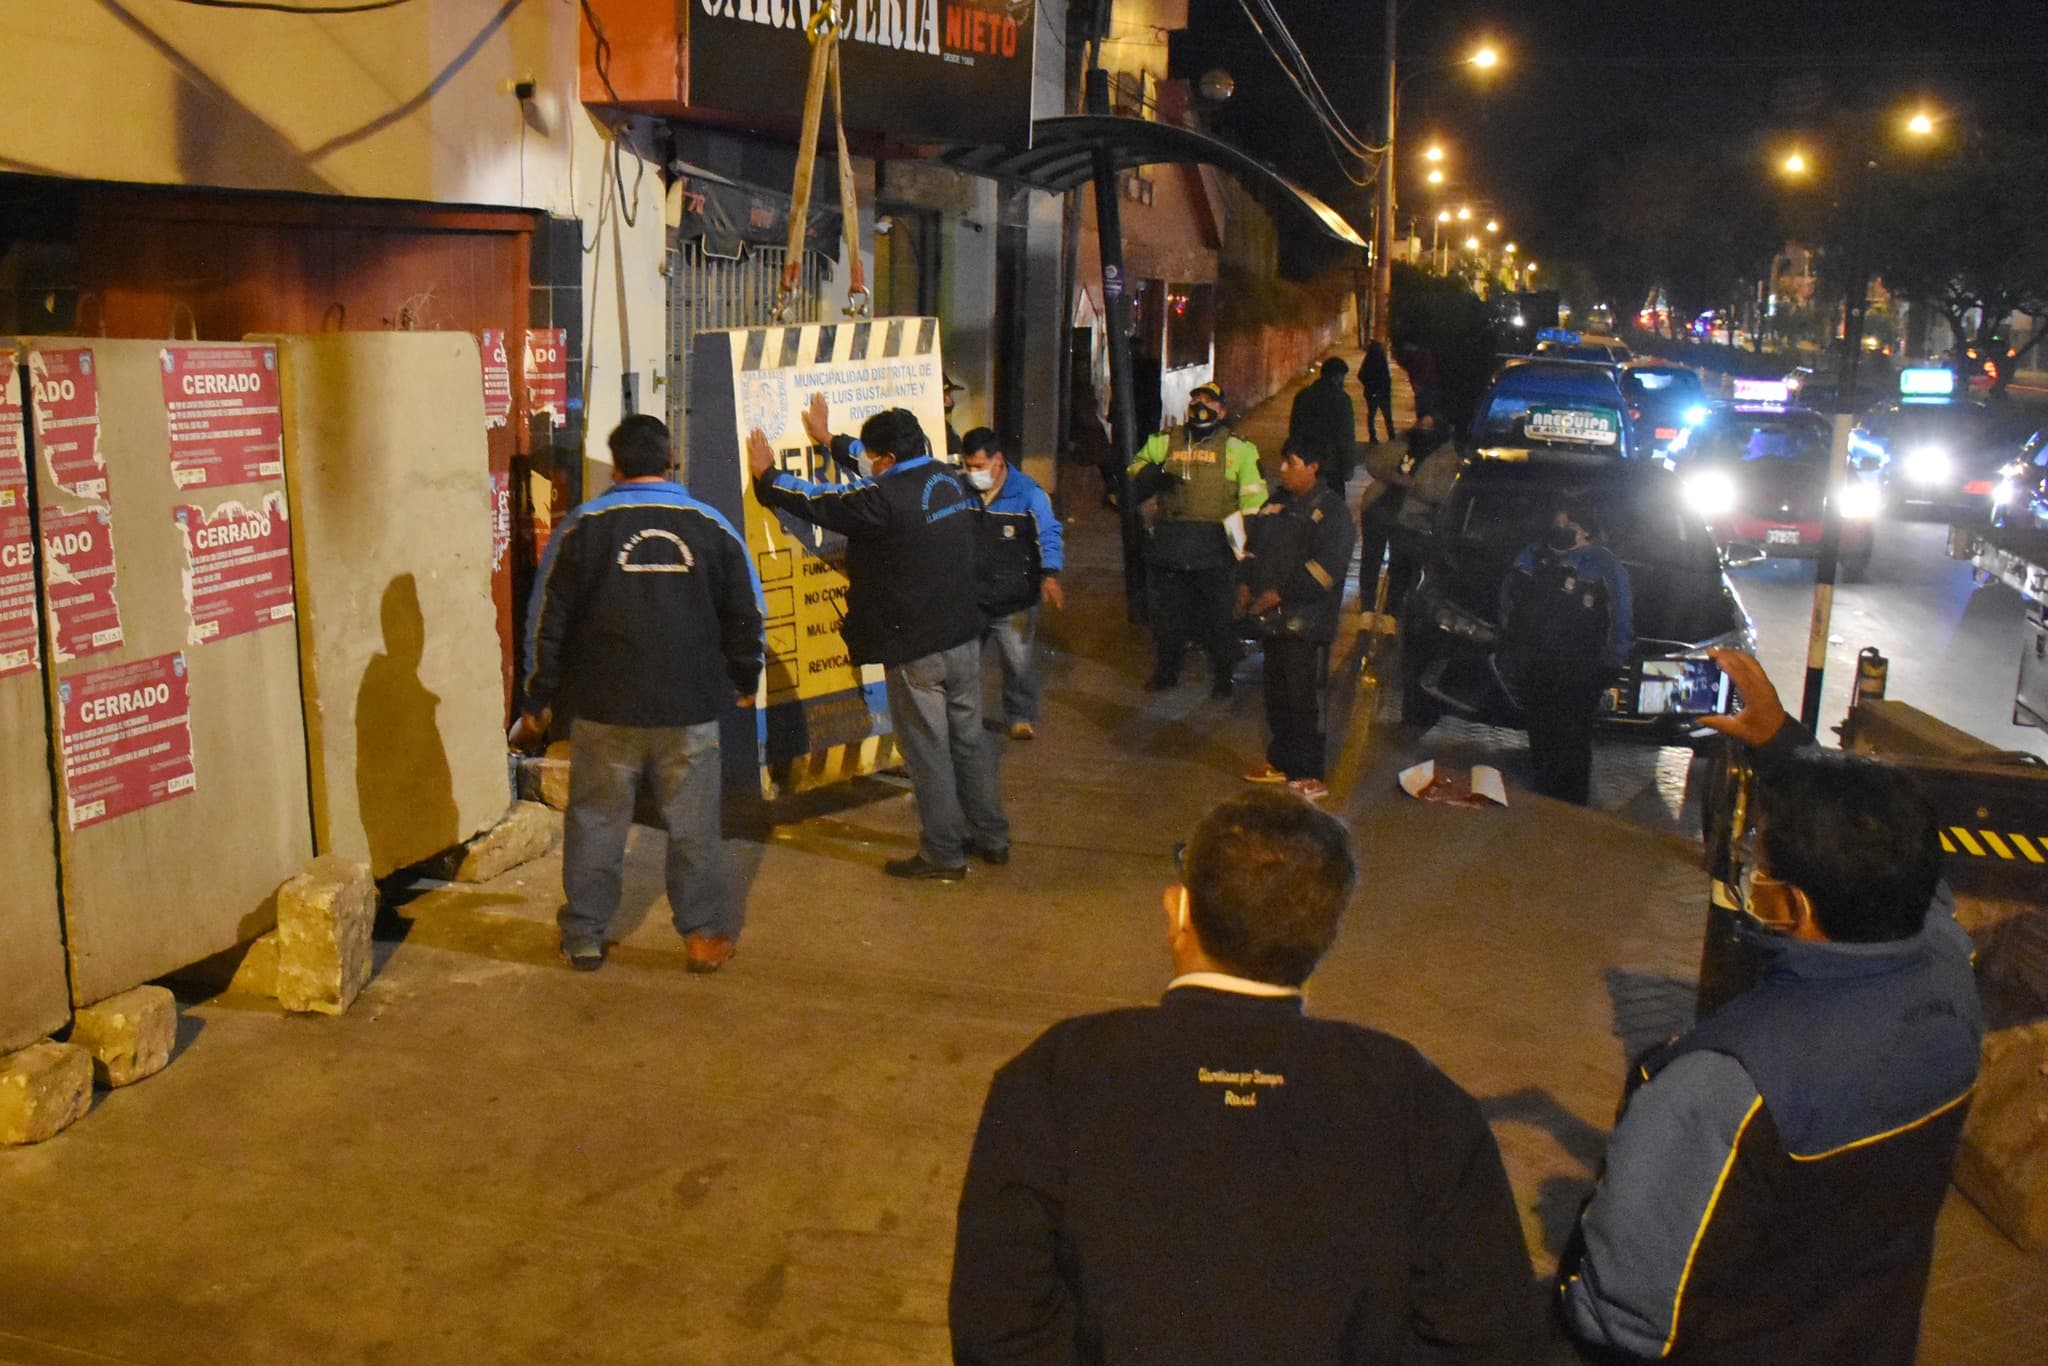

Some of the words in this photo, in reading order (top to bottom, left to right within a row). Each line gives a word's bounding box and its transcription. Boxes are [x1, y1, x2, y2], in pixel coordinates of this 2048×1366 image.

[702, 0, 940, 56] CERIA
[945, 5, 1018, 57] NIETO
[183, 373, 261, 395] CERRADO
[794, 369, 869, 388] MUNICIPALIDAD
[919, 364, 932, 377] DE
[832, 389, 853, 404] LUIS
[856, 383, 918, 401] BUSTAANTE
[919, 382, 926, 395] Y
[1533, 413, 1609, 431] AREQUIPA
[196, 518, 272, 549] CERRADO
[804, 591, 820, 605] NO
[823, 585, 849, 601] CONT
[807, 622, 827, 637] MAL
[830, 620, 843, 633] US
[808, 656, 850, 674] REVOCA
[81, 683, 169, 723] CERRADO
